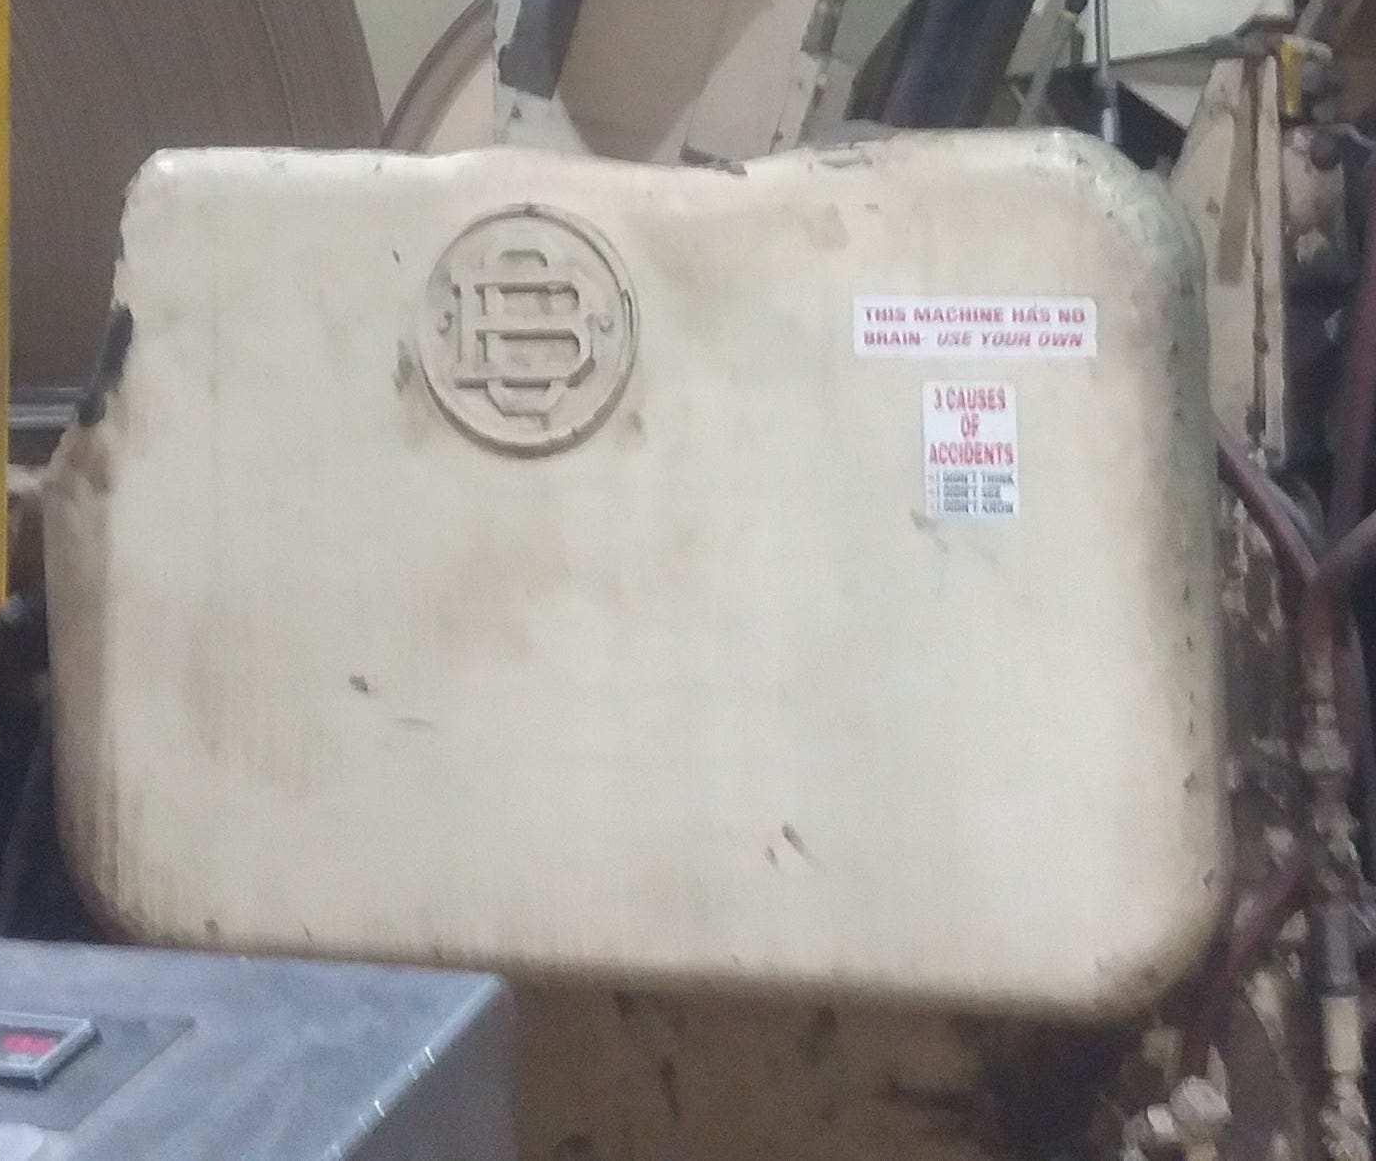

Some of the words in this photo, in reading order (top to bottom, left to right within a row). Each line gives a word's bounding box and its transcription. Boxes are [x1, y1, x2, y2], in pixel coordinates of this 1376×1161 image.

[864, 306, 906, 323] THIS
[914, 306, 1004, 323] MACHINE
[1012, 306, 1050, 323] HAS
[1058, 306, 1086, 323] NO
[937, 331, 973, 347] USE
[981, 331, 1031, 348] YOUR
[1038, 332, 1084, 348] OWN
[946, 388, 1007, 412] CAUSES
[960, 413, 980, 438] OF
[928, 442, 1014, 466] ACCIDENTS
